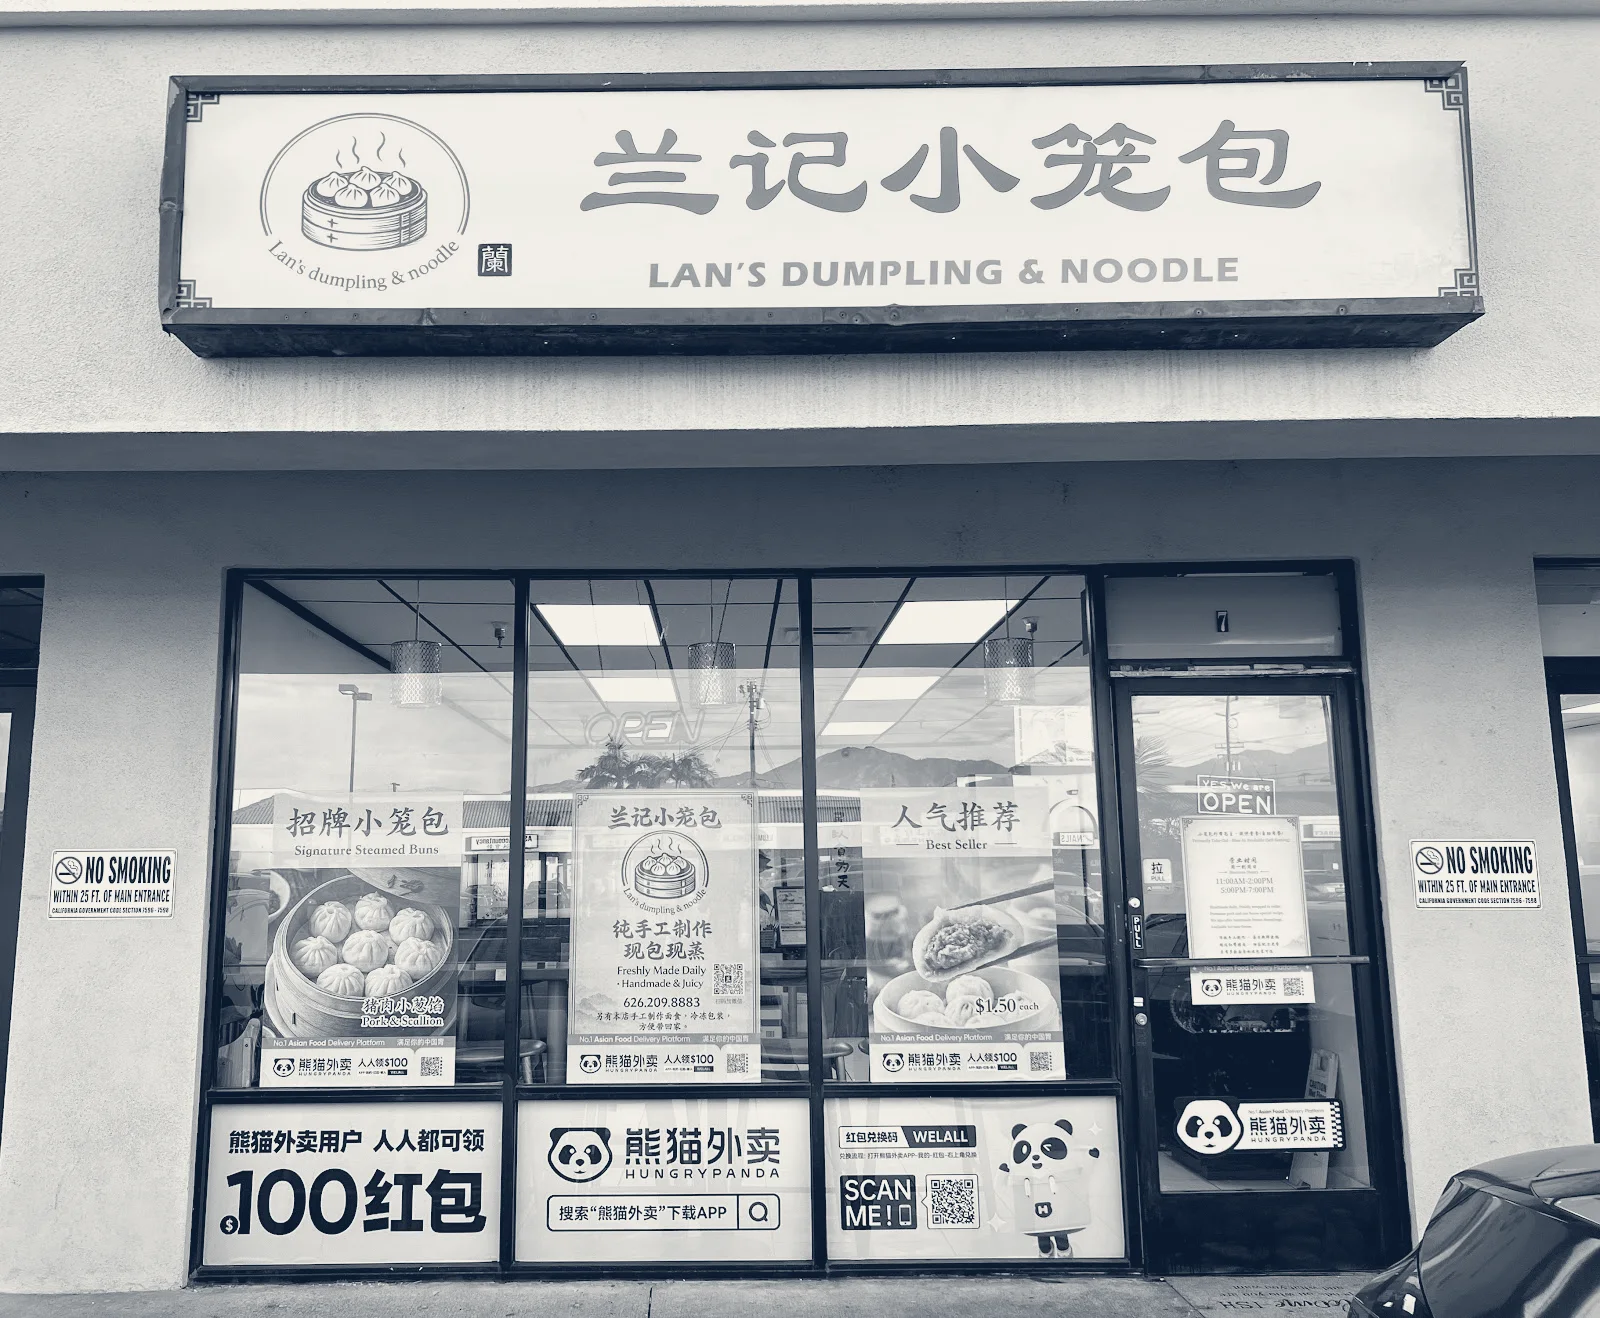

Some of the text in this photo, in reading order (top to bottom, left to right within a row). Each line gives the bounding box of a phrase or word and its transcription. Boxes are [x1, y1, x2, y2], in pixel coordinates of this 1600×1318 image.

[580, 119, 1321, 214] 兰记小笼包
[268, 240, 460, 292] Lan's dumpling & noodle
[480, 244, 511, 275] 蘭
[648, 257, 1239, 289] LAN'S DUMPLING & NOODLE
[1217, 611, 1227, 632] 7
[585, 709, 705, 747] OPEN
[1253, 784, 1271, 792] are
[1203, 792, 1271, 815] OPEN
[286, 806, 449, 838] 招牌小笼包
[608, 805, 722, 829] 兰记小笼包
[891, 801, 1020, 832] 人气推荐
[294, 844, 439, 858] Signature Steamed Buns
[926, 839, 988, 850] Best Seller
[1445, 846, 1533, 874] NO SMOKING
[85, 856, 171, 884] NO SMOKING
[1151, 862, 1164, 874] 拉
[1216, 877, 1273, 885] 11:00AM-2:00PM
[1418, 880, 1536, 893] WITHIN 25 FT. OF MAIN ENTRANCE
[53, 889, 170, 903] WITHIN 25 FT. OF MAIN ENTRANCE
[623, 888, 707, 915] Lan's dumpling & noodle
[612, 919, 713, 939] 纯手工制作
[1133, 916, 1142, 948] PULL
[623, 941, 705, 961] 现包现蒸
[617, 966, 706, 977] Freshly Made Daily
[622, 979, 704, 989] Handmade & Juicy
[1226, 979, 1276, 991] 熊猫外卖
[361, 995, 444, 1015] 猪肉小葱馅
[623, 997, 701, 1008] 626.209.8883
[975, 998, 1039, 1015] $1.50 each
[361, 1014, 444, 1027] Pork & Scallion
[273, 1038, 385, 1048] No.1 Asian Food Delivery Platform
[633, 1036, 661, 1044] Delivery
[661, 1035, 690, 1043] Platform
[880, 1034, 895, 1042] No.1
[895, 1034, 915, 1042] Asian
[916, 1034, 933, 1042] Food
[935, 1034, 962, 1043] Delivery
[299, 1058, 352, 1071] 熊猫外卖
[358, 1057, 408, 1068] 人人领$100
[606, 1054, 658, 1068] 熊猫外卖
[664, 1054, 714, 1064] 人人领$100
[908, 1053, 961, 1066] 熊猫外卖
[967, 1052, 1017, 1063] 人人领$100
[1250, 1116, 1326, 1136] 熊猫外卖
[228, 1129, 485, 1154] 熊猫外卖用户 人人都可领
[845, 1130, 968, 1143] 红包兑换码 WELALL
[625, 1127, 780, 1165] 熊猫外卖
[625, 1168, 780, 1179] HUNGRYPANDA
[844, 1178, 912, 1200] SCAN
